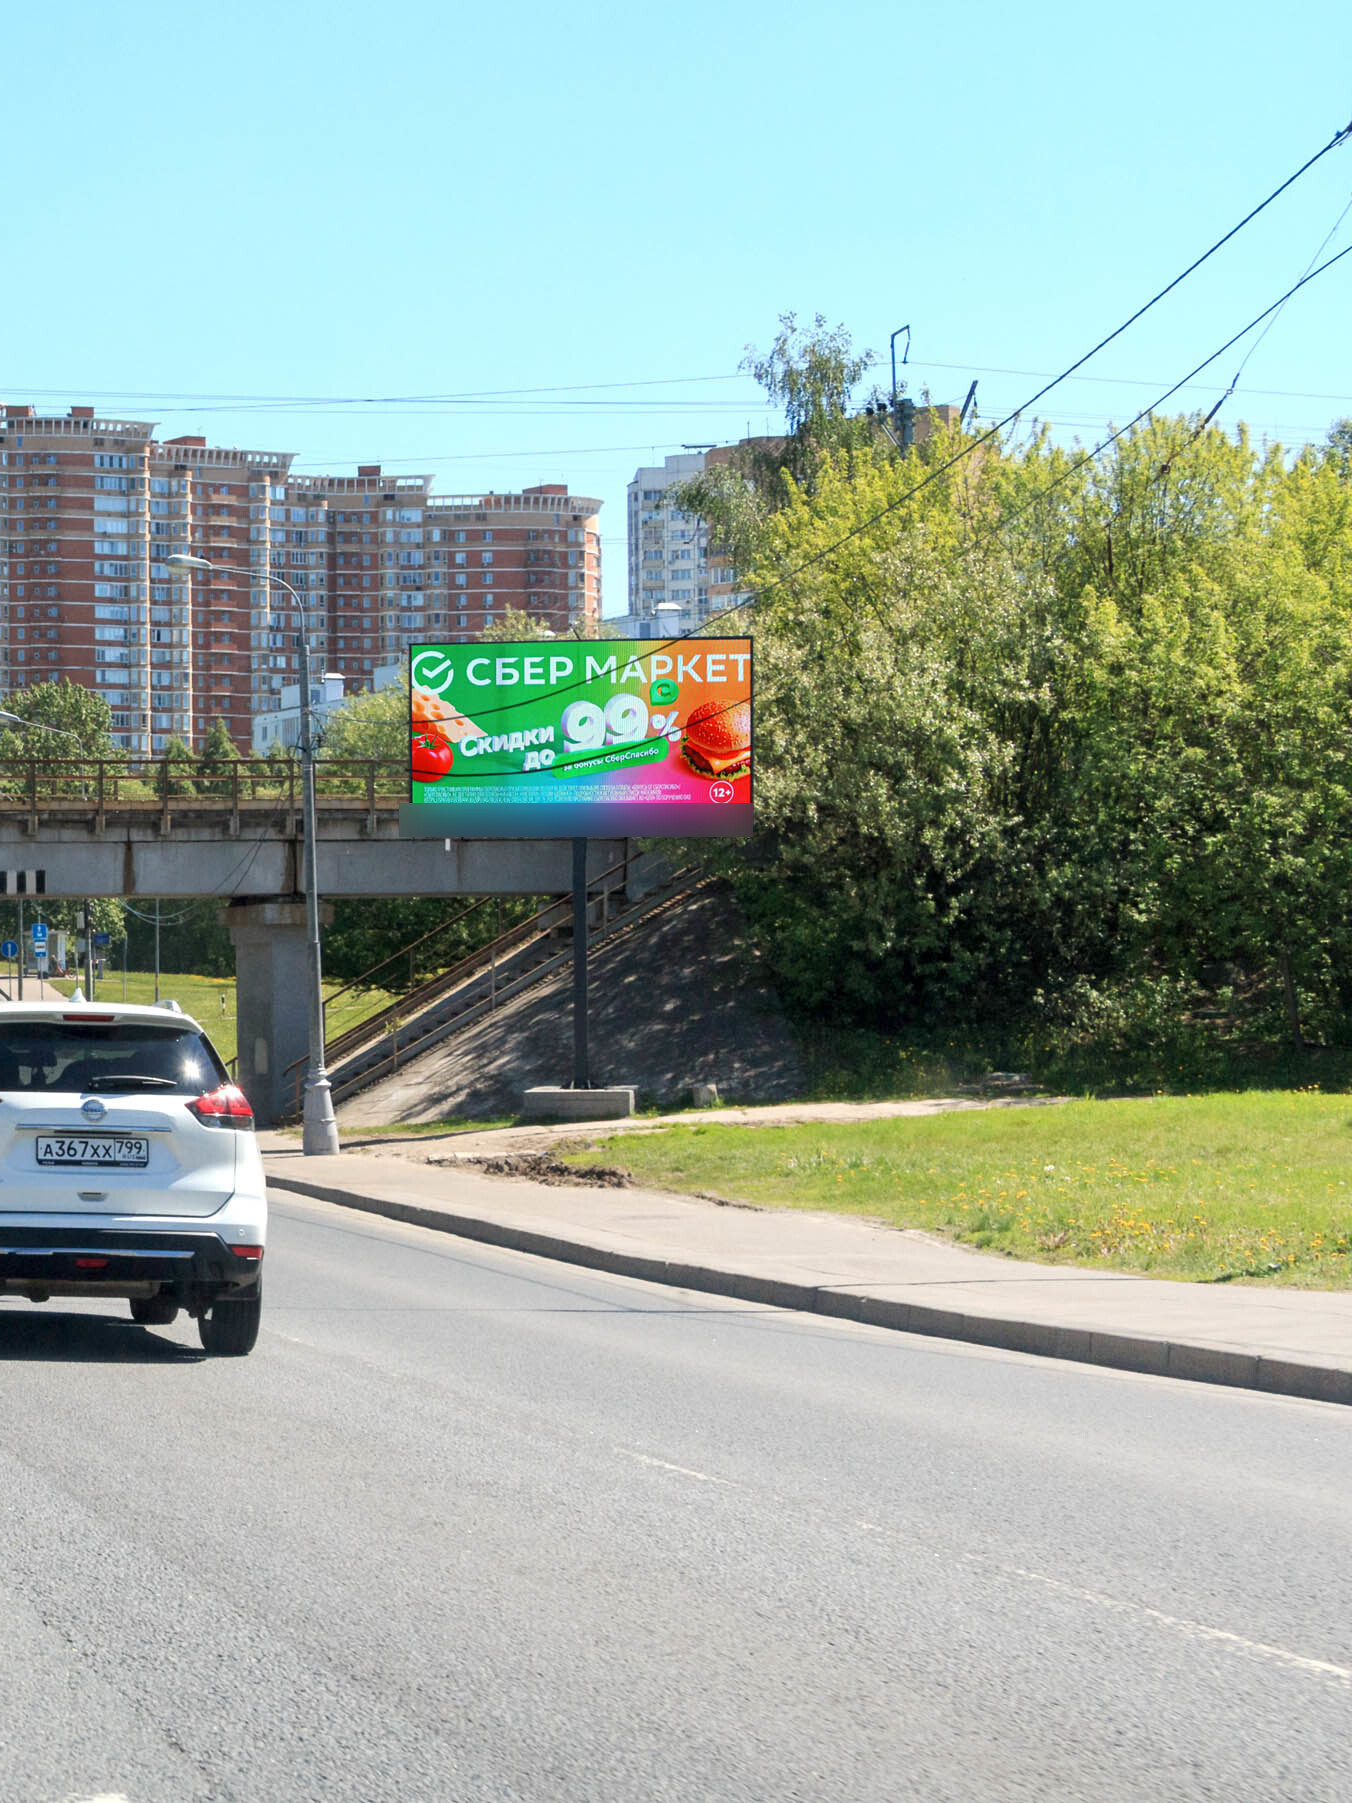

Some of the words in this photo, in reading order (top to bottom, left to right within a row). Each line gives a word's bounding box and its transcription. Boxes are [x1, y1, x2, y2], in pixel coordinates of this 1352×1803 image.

[466, 656, 573, 686] СБЕР
[585, 653, 751, 684] МАРКЕТ
[458, 725, 555, 757] Скидки
[522, 747, 556, 771] до
[604, 747, 659, 764] СберСпасибо
[713, 787, 731, 798] 12+
[116, 1140, 142, 1155] 799
